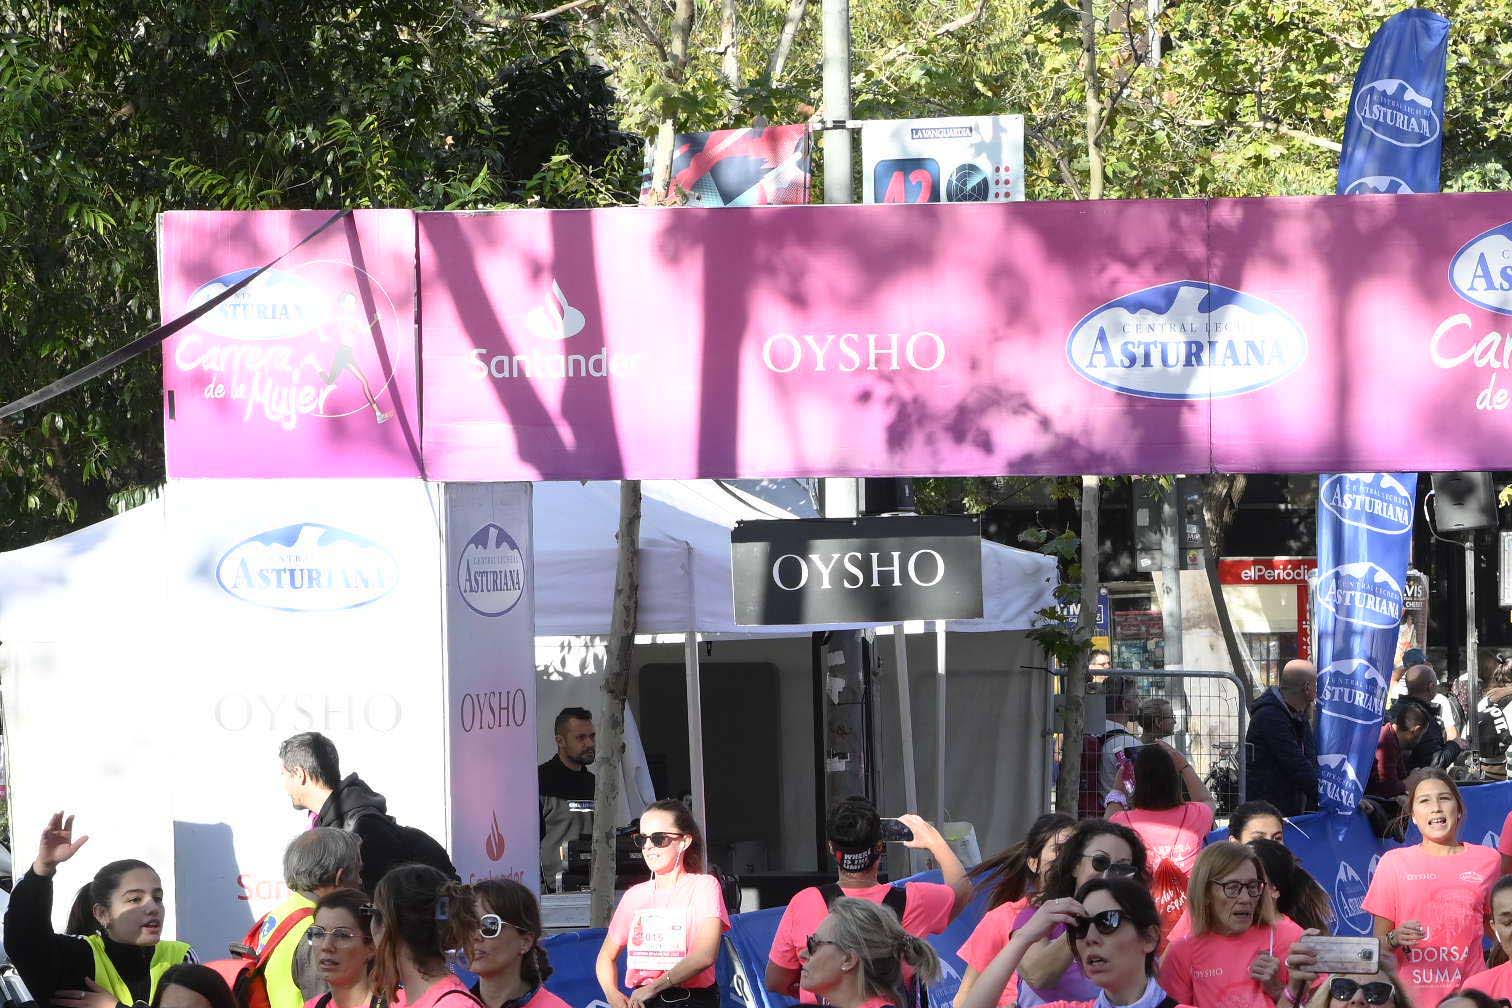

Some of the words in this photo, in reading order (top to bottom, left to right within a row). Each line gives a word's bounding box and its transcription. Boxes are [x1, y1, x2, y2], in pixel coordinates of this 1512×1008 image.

[923, 127, 971, 138] VANGUARDIA
[1122, 322, 1198, 333] CENTRAL
[176, 334, 294, 372] Carrera
[471, 347, 642, 379] Santander
[763, 331, 946, 374] OYSHO
[1086, 326, 1287, 369] ASTURIANA
[204, 377, 226, 399] de
[244, 369, 337, 431] Mujer
[1475, 373, 1509, 410] de
[1331, 484, 1409, 525] ASTURIANA
[231, 556, 387, 590] ASTURIANA
[464, 559, 521, 594] ASTURIANA
[773, 549, 945, 591] OYSHO
[1327, 580, 1400, 619] ASTURIANA
[214, 692, 403, 732] OYSHO
[461, 688, 526, 734] OYSHO
[1411, 945, 1469, 963] DORSA
[1413, 967, 1462, 984] SUMA
